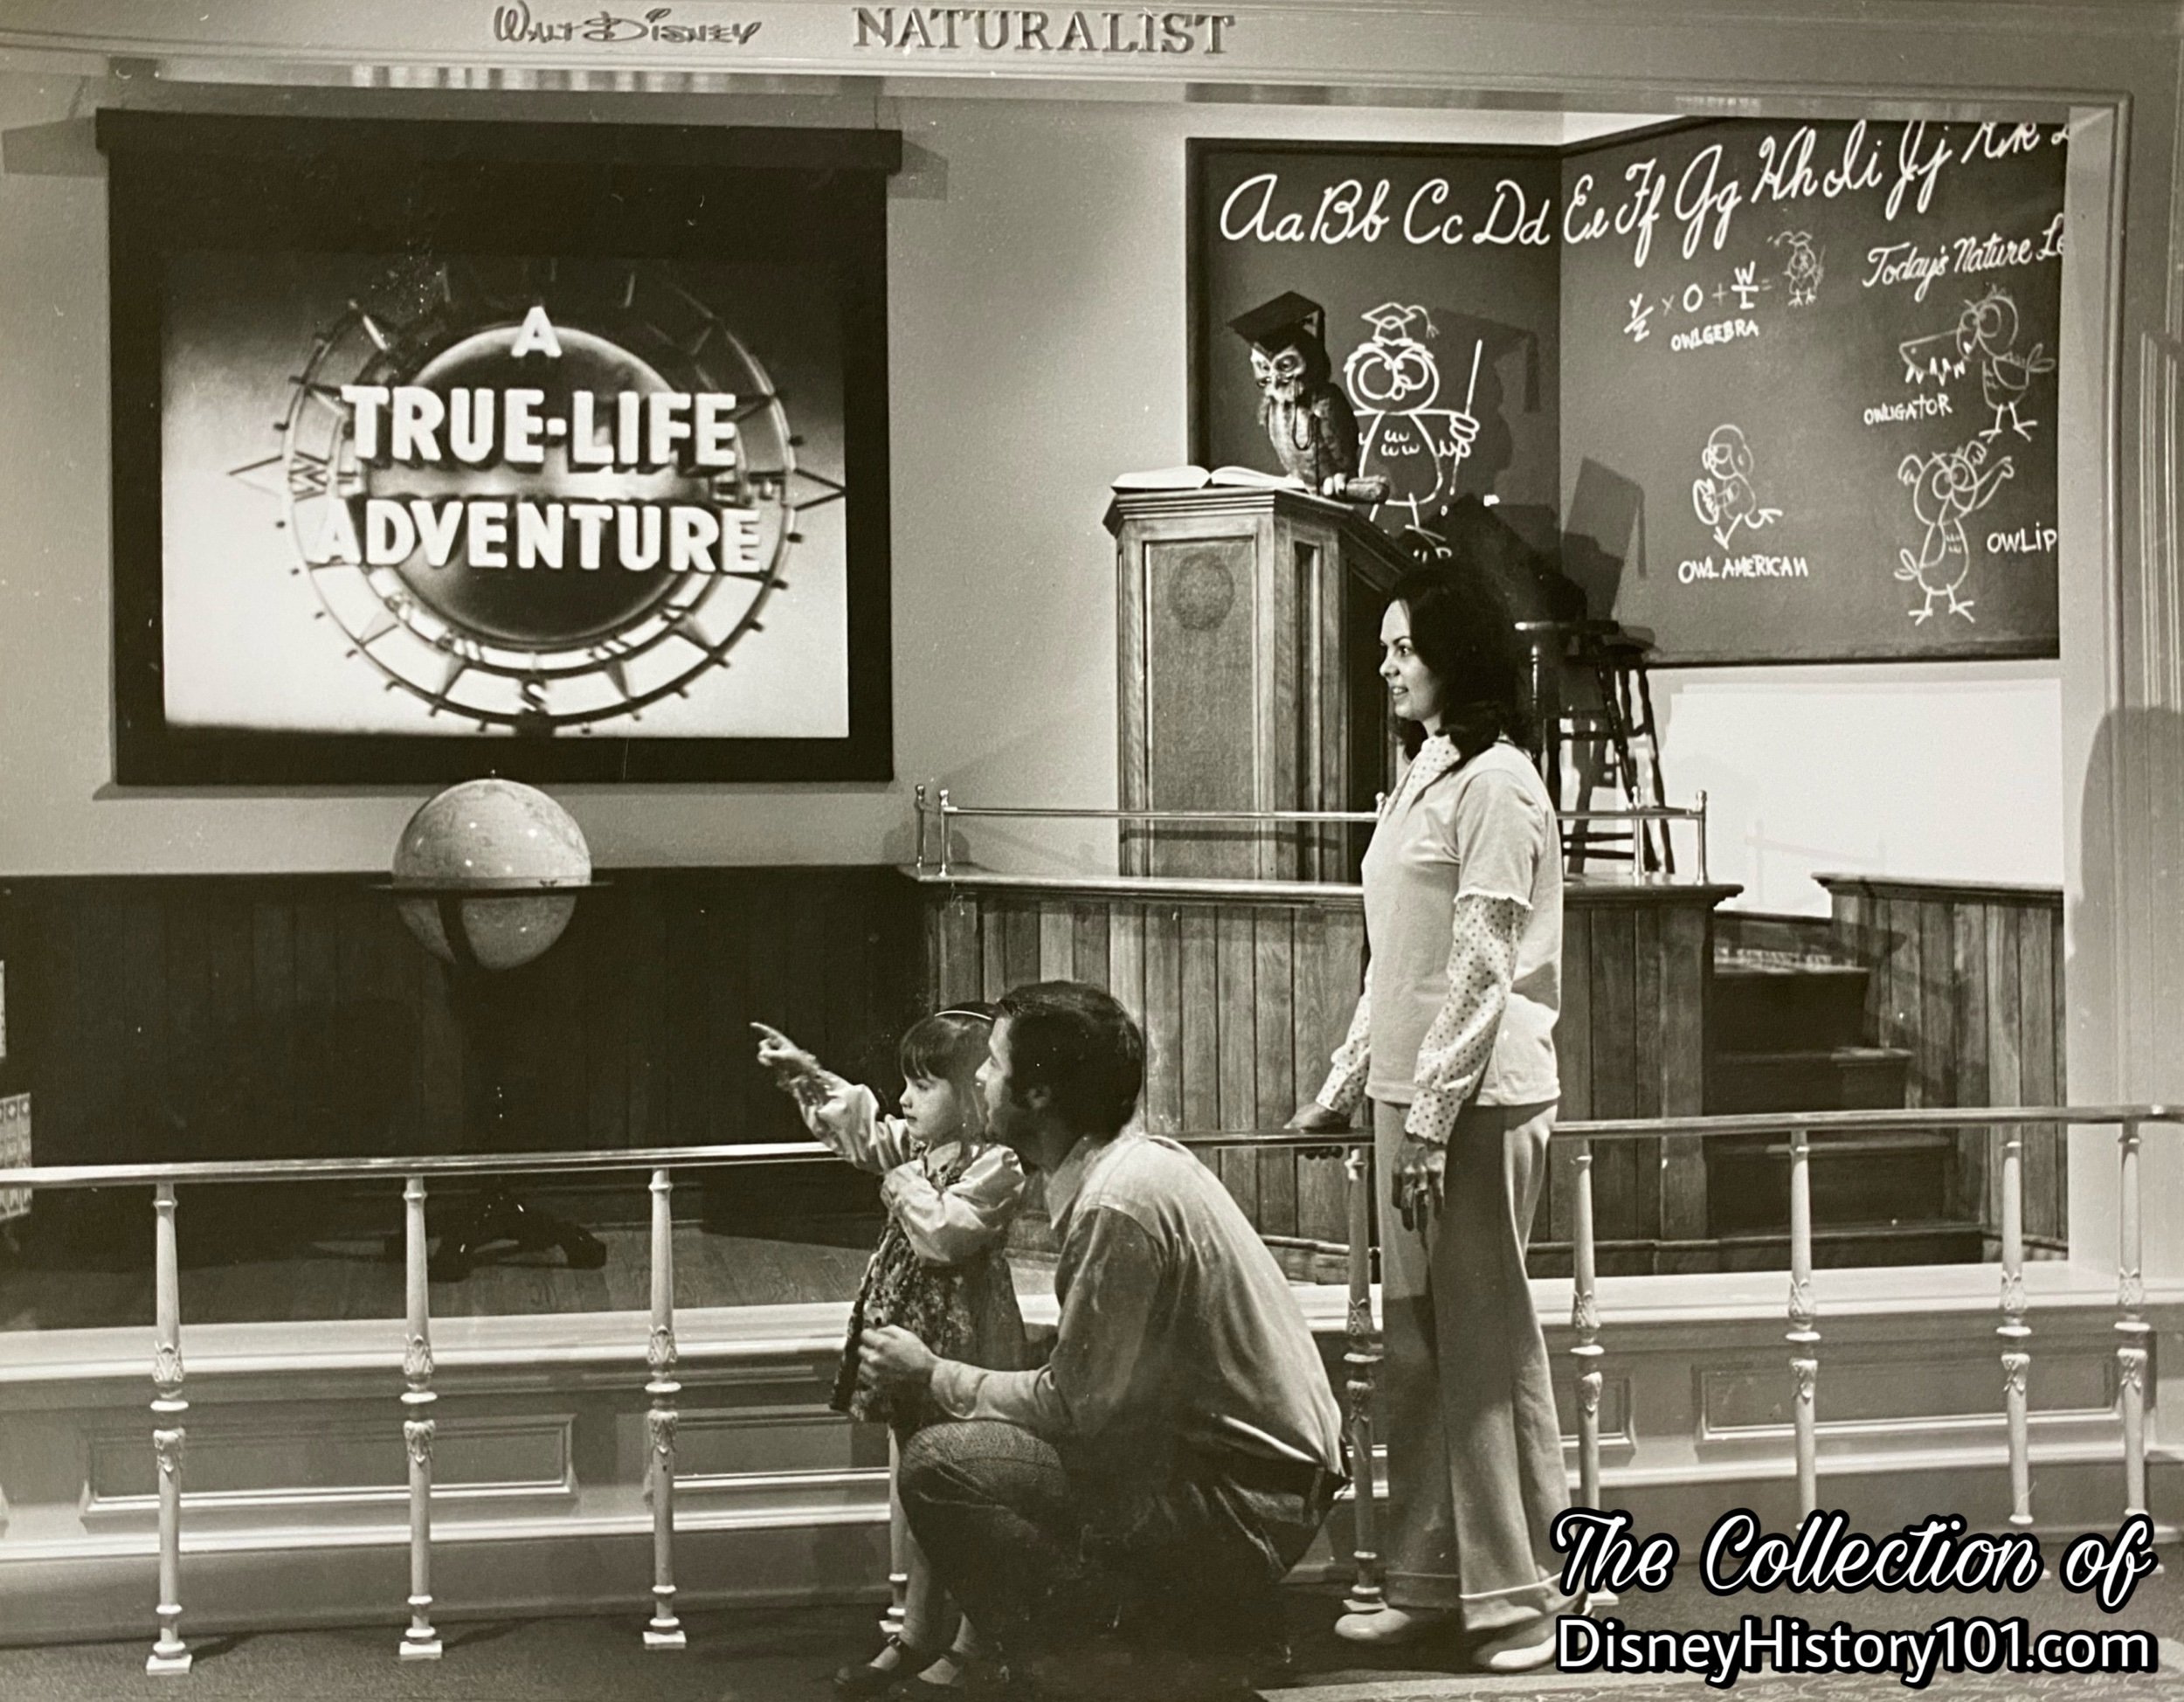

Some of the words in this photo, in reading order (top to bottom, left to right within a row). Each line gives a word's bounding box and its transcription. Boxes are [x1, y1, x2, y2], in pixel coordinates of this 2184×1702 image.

[851, 5, 1236, 55] NATURALIST
[1220, 173, 1304, 242] Aa
[1310, 178, 1390, 245] Bb
[1402, 177, 1463, 245] Cc
[1472, 179, 1551, 246] Dd
[1563, 174, 1609, 245] Ee
[1614, 158, 1666, 269] Ff
[1674, 144, 1743, 260] Gg
[1862, 241, 1949, 302] Today's
[1953, 232, 2033, 273] Nature
[511, 306, 562, 357] A
[1670, 318, 1759, 351] OWLGEBRA
[342, 386, 737, 466] TRUE-LIFE
[305, 501, 760, 573] ADVENTURE
[1677, 556, 1719, 584] OWL
[1721, 553, 1809, 578] AMERICAN
